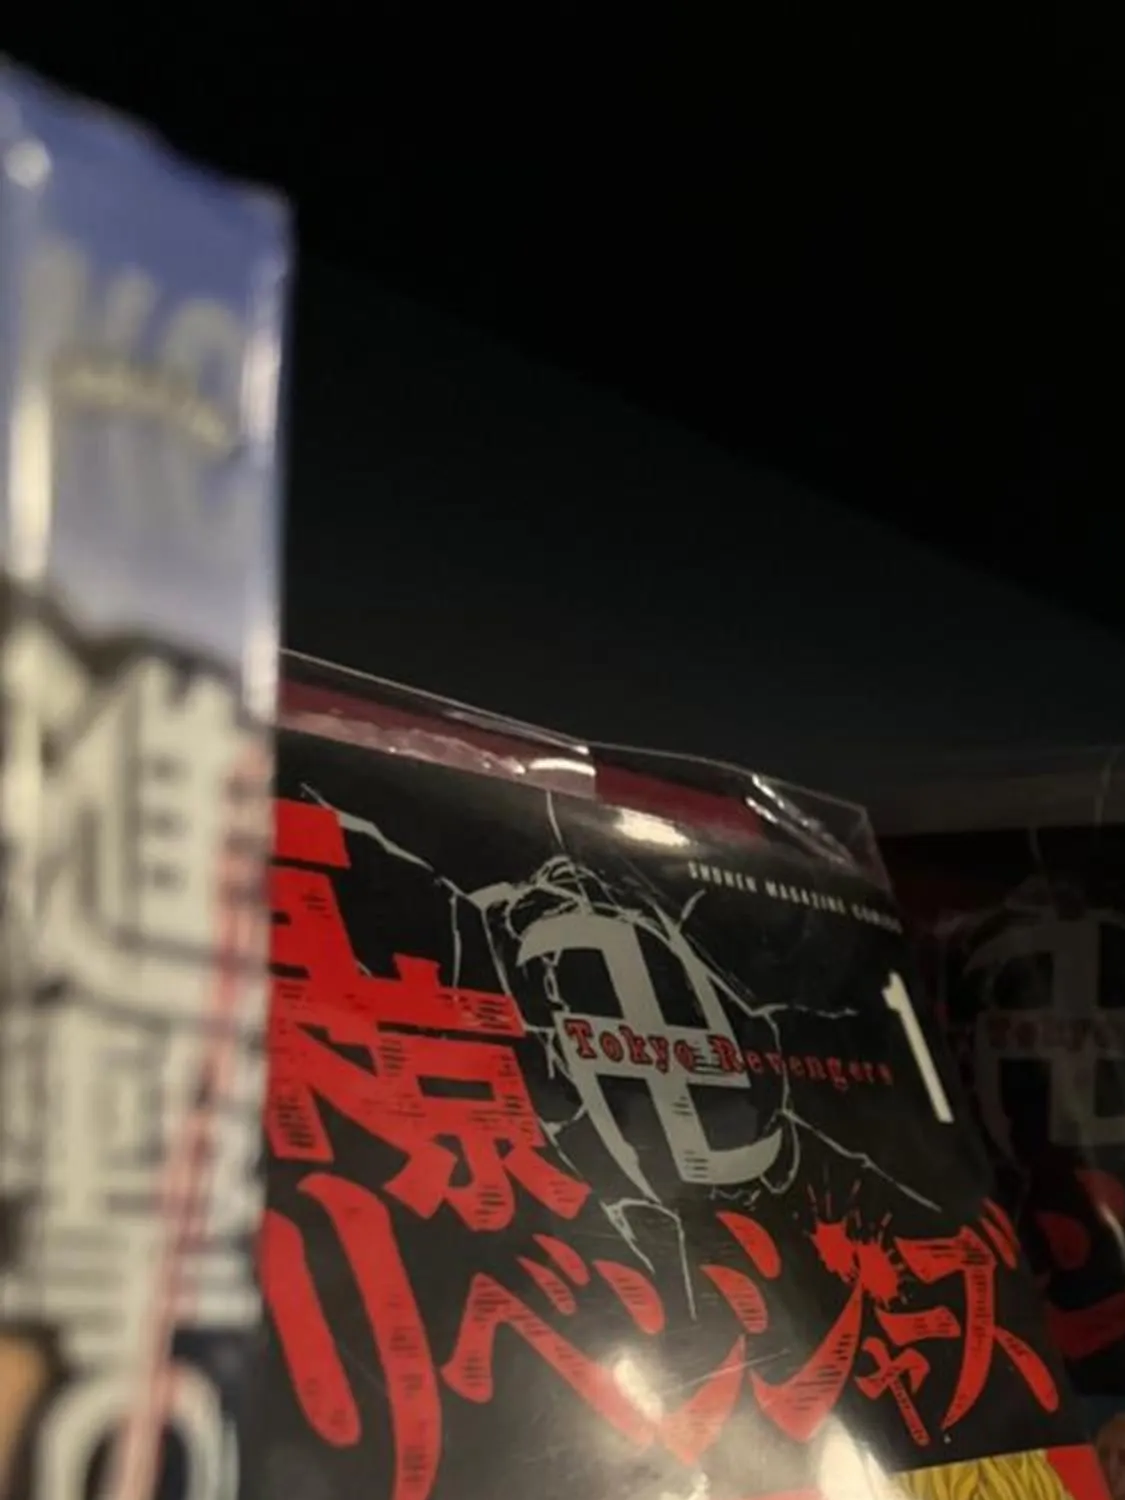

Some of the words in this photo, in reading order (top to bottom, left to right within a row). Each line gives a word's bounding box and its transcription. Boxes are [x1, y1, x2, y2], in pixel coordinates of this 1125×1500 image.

[563, 1018, 698, 1075] Tokyo
[704, 1033, 894, 1093] Revengers
[881, 968, 954, 1124] 1
